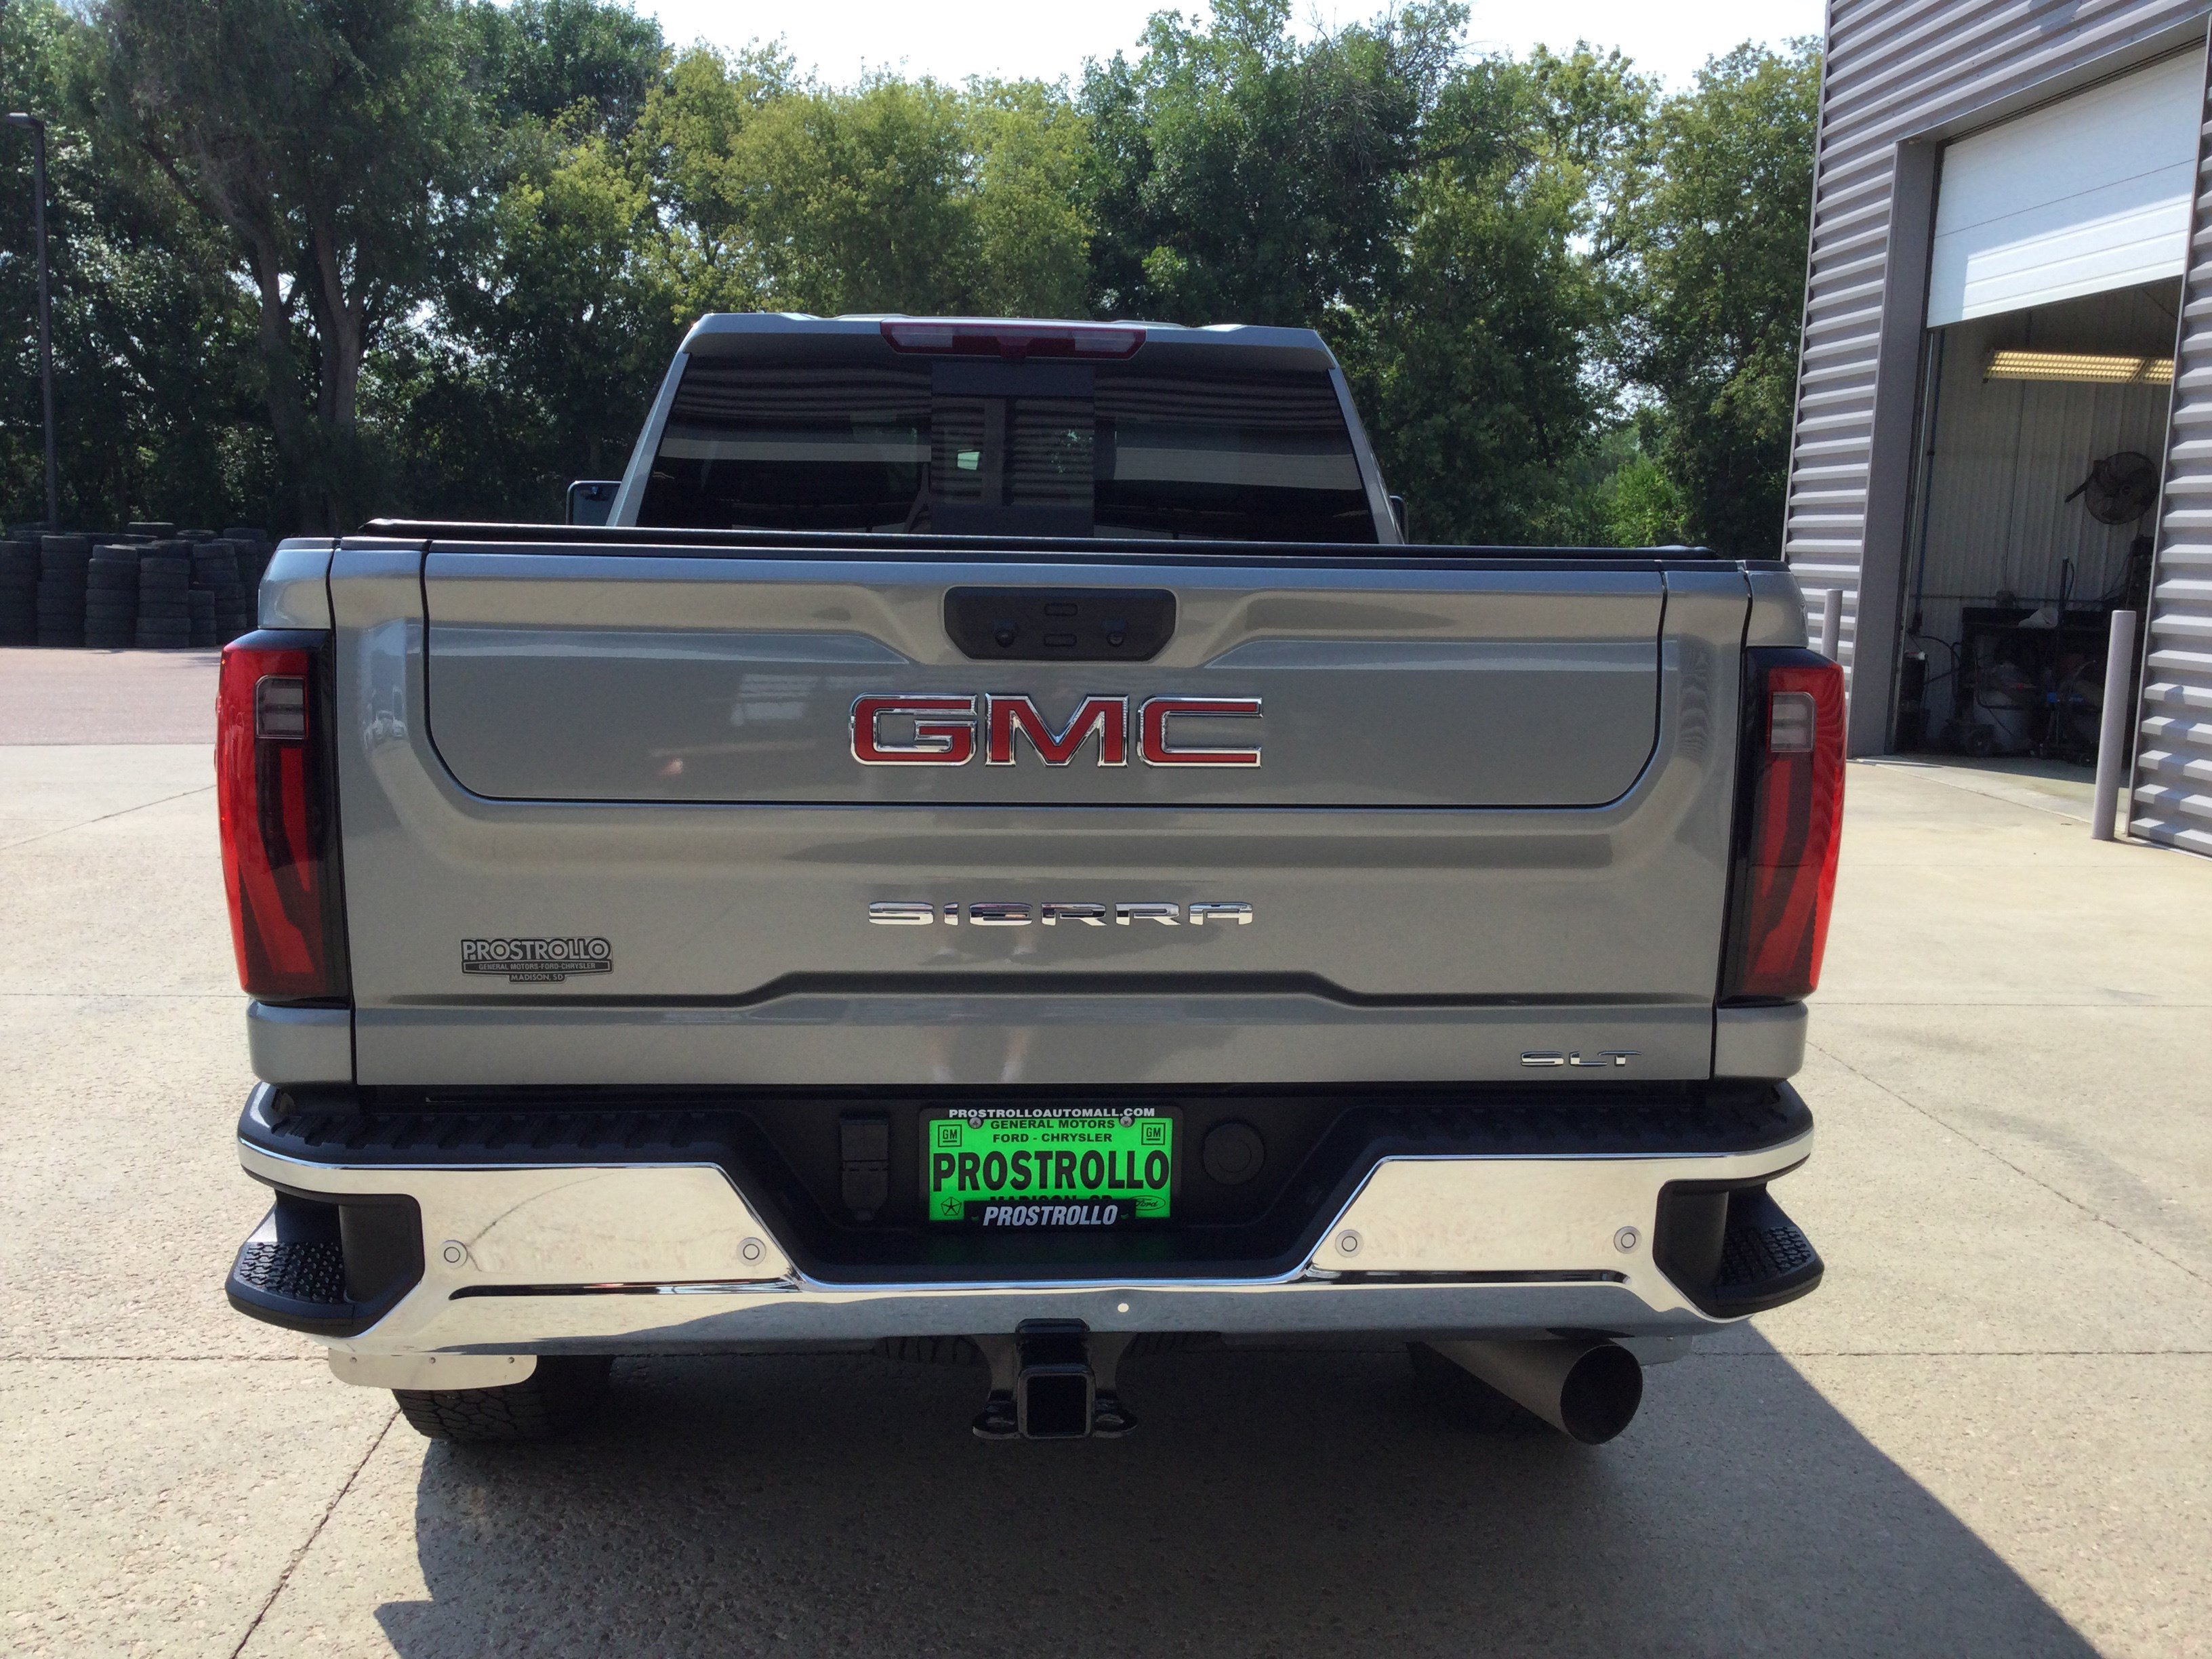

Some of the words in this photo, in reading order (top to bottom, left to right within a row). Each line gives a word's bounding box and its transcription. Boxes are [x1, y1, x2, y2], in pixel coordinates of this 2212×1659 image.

[849, 692, 1263, 768] GMC
[868, 902, 1254, 926] SIERRA
[1521, 1050, 1643, 1067] SLT
[949, 1107, 1155, 1119] PROSTROLLOAUTOMALL.COM
[990, 1120, 1054, 1130] GENERAL
[1058, 1119, 1115, 1128] MOTORS
[1145, 1126, 1162, 1137] GM
[942, 1129, 958, 1140] GM
[993, 1133, 1029, 1143] FORD
[1041, 1132, 1113, 1143] CHRYSLER
[933, 1149, 1170, 1192] PROSTROLLO
[983, 1204, 1118, 1226] PROSTROLLO
